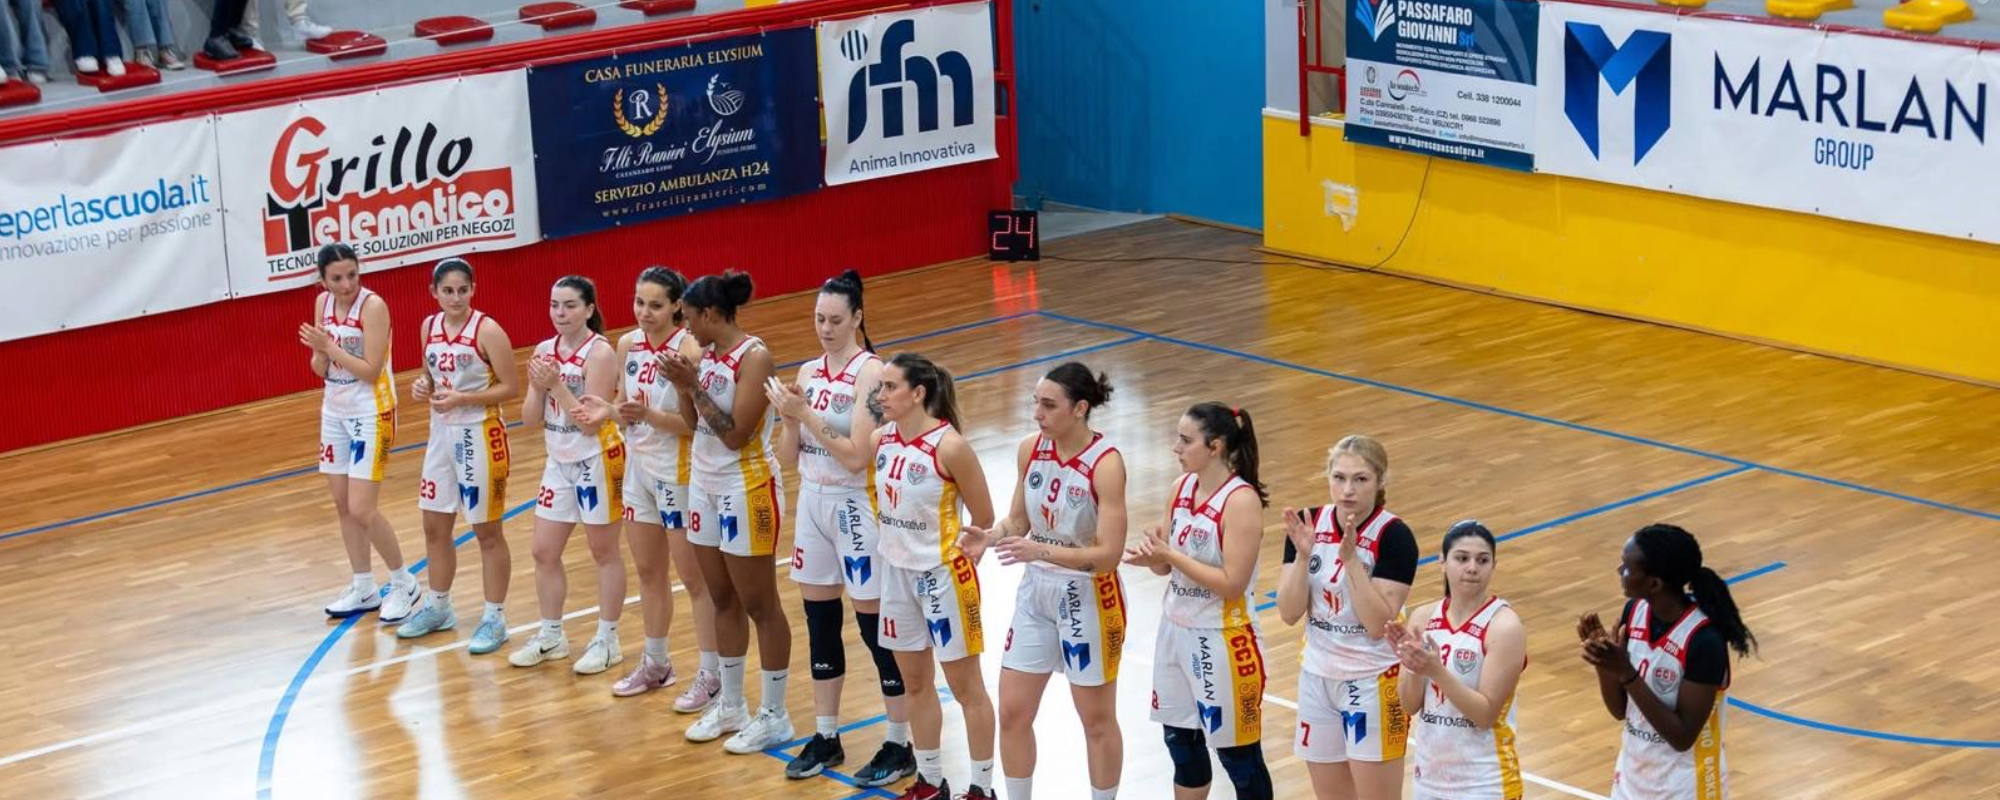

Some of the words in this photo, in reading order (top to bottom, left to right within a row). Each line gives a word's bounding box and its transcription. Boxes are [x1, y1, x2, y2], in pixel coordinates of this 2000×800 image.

[1398, 0, 1472, 26] PASSAFARO
[1398, 20, 1457, 45] GIOVANNI
[585, 66, 621, 83] CASA
[625, 54, 704, 77] FUNERARIA
[708, 45, 764, 65] ELYSIUM
[1457, 90, 1474, 101] Cell.
[1476, 93, 1490, 103] 338
[1492, 96, 1522, 107] 1200044
[1714, 50, 1987, 145] MARLAN
[270, 116, 473, 202] Grillo
[634, 141, 688, 166] Ranieri
[692, 119, 755, 165] Elysium
[849, 154, 897, 174] Anima
[900, 141, 977, 168] Innovativa
[1814, 137, 1874, 171] GROUP
[595, 182, 655, 204] SERVIZIO
[659, 167, 738, 193] AMBULANZA
[741, 161, 770, 178] H24
[0, 174, 210, 239] eperlascuola.it
[266, 183, 510, 252] Telematico
[0, 231, 100, 260] nnovazione
[107, 226, 135, 249] per
[141, 210, 212, 242] passione
[268, 253, 320, 273] TECNOL
[363, 232, 433, 255] SOLUZIONI
[436, 226, 459, 240] PER
[461, 218, 515, 237] NEGOZI
[993, 215, 1034, 250] 24
[438, 352, 456, 372] 23
[638, 362, 658, 385] 20
[814, 389, 831, 410] 15
[463, 428, 475, 482] MARLAN
[488, 427, 505, 462] CCB
[888, 455, 906, 481] 11
[420, 479, 436, 500] 23
[537, 485, 554, 508] 22
[1047, 478, 1060, 502] 9
[1178, 524, 1192, 546] 8
[953, 555, 971, 584] CB
[1330, 558, 1343, 583] 7
[924, 570, 942, 614] ARLAN
[1067, 579, 1083, 638] MARLAN
[884, 616, 897, 639] 11
[1198, 635, 1215, 701] MARLAN
[1231, 635, 1255, 678] CCB
[1301, 720, 1311, 747] 7
[1704, 757, 1717, 800] BASKE
